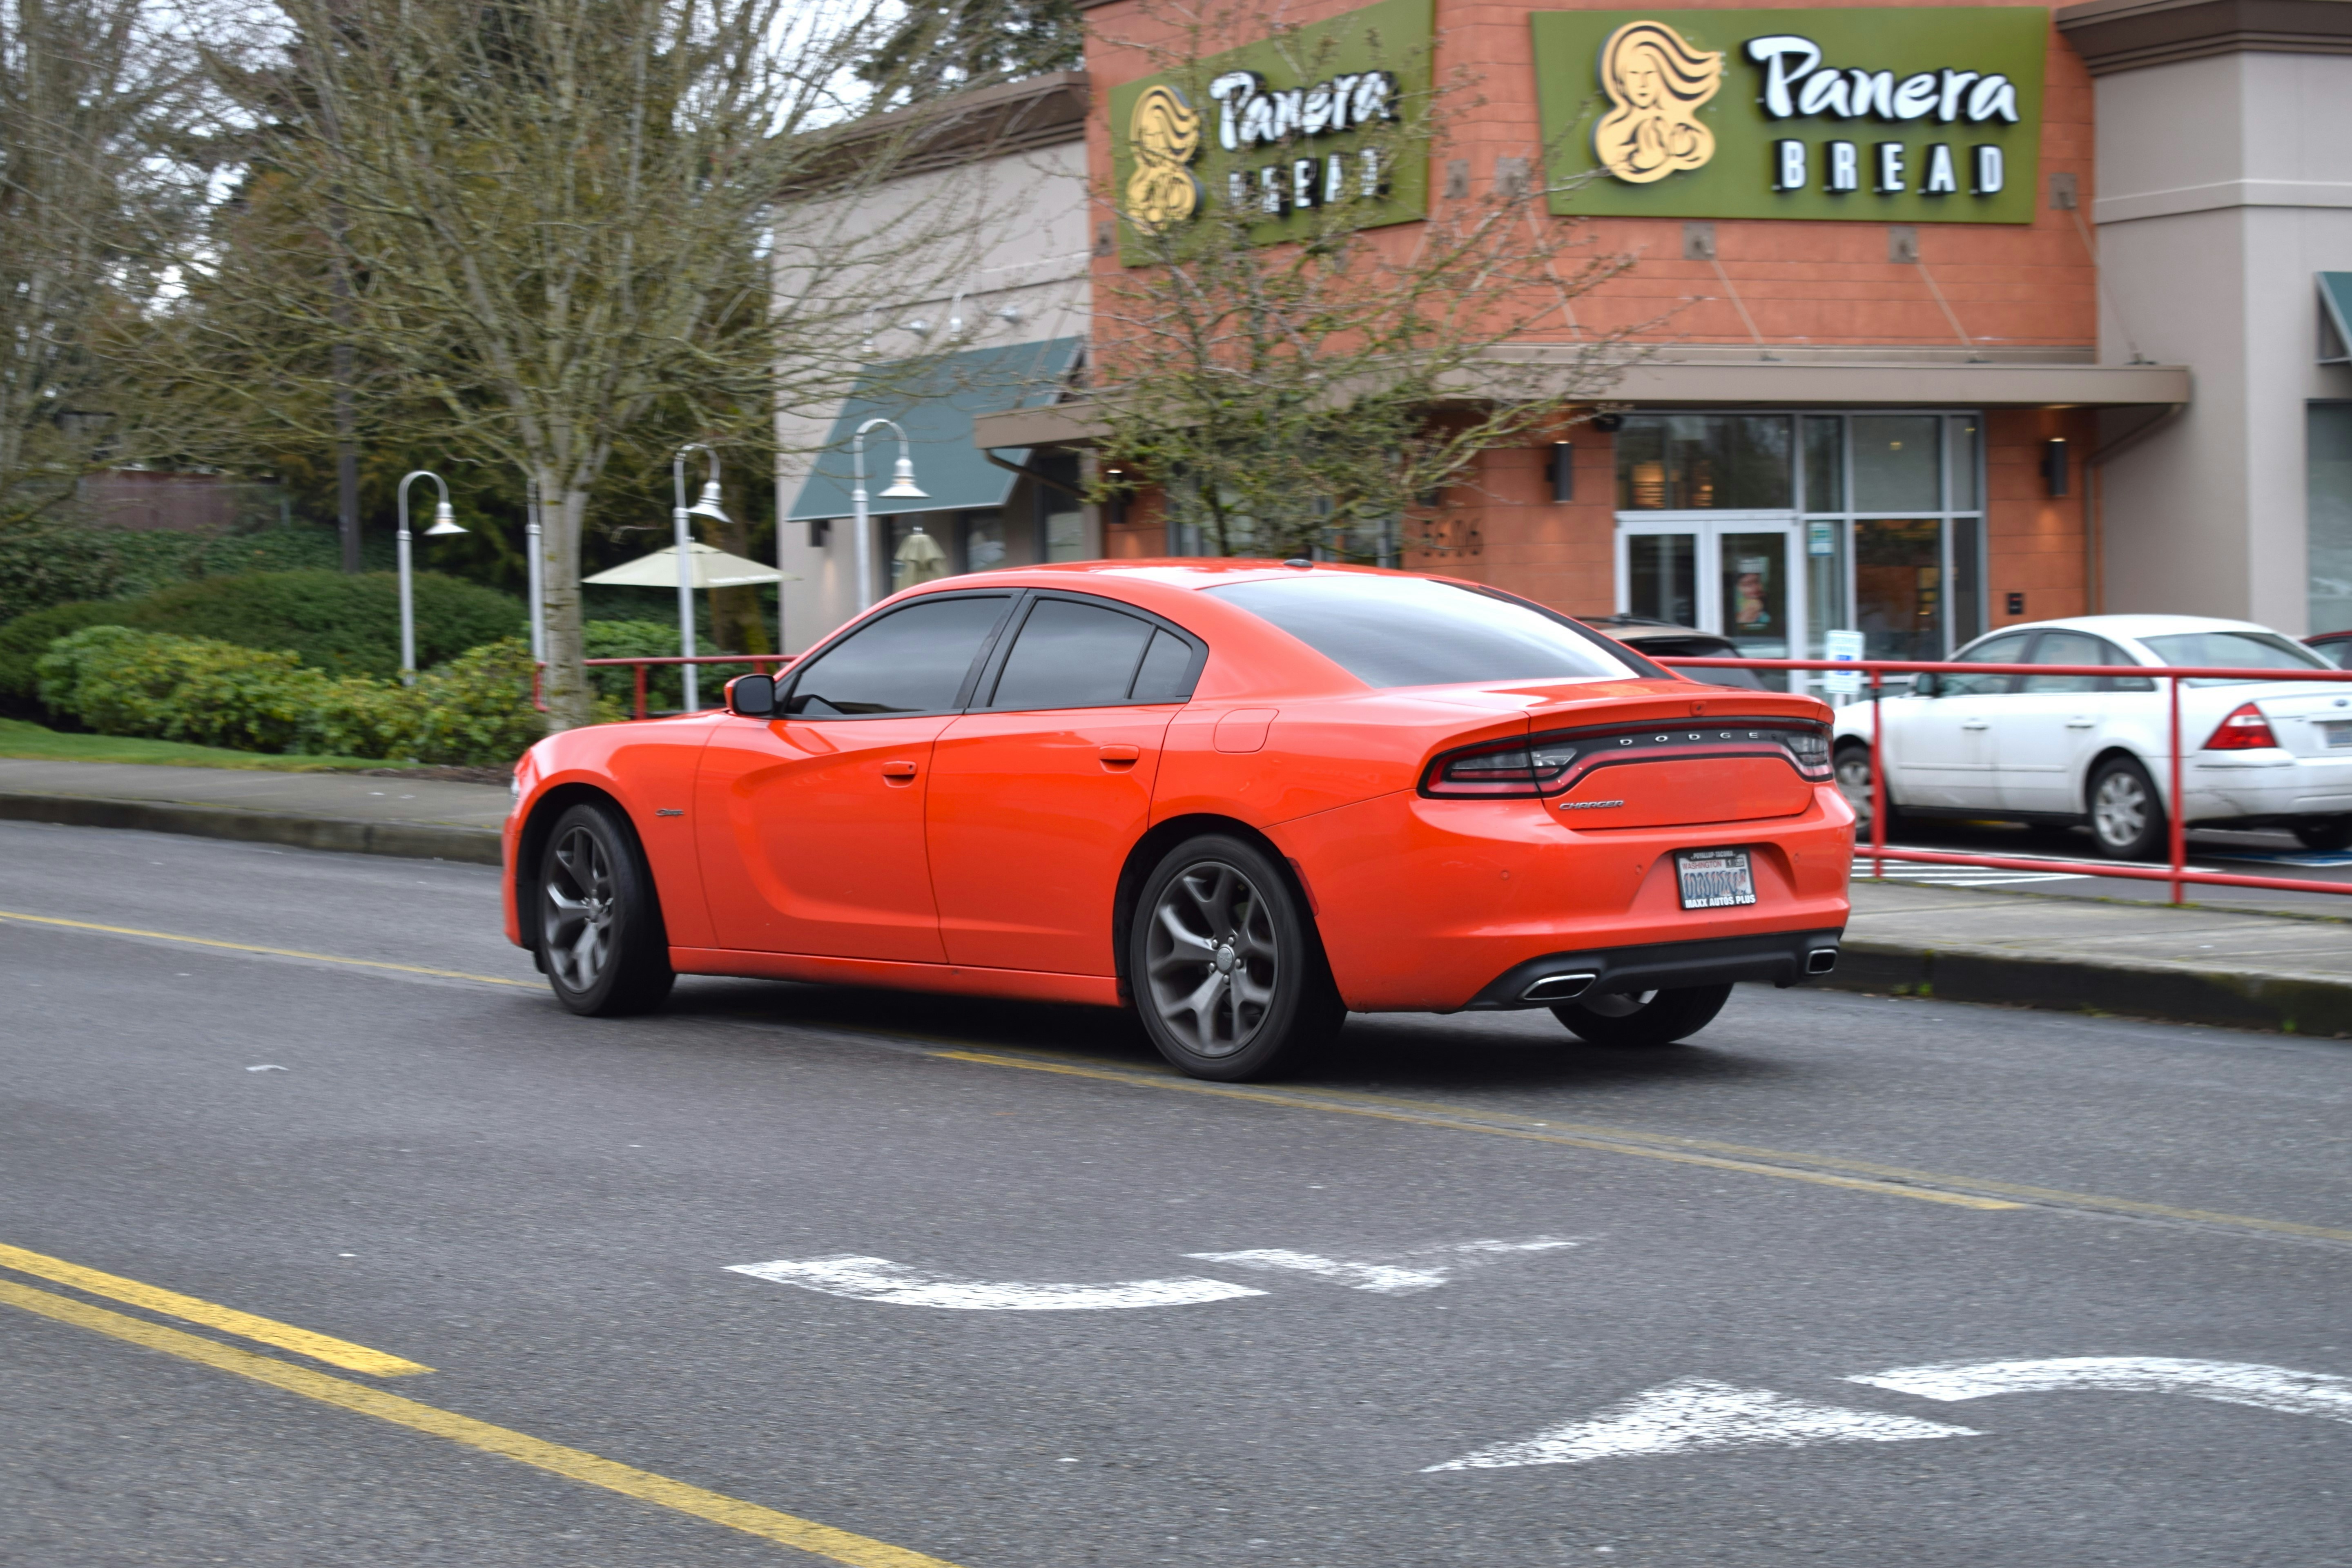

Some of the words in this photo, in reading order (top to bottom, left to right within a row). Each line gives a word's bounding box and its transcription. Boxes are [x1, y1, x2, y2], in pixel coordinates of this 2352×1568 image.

[1748, 35, 2020, 122] Panera
[1210, 71, 1392, 150] Panera
[1781, 140, 2004, 193] BREAD
[1619, 732, 1758, 746] DODGE
[1559, 800, 1624, 810] CHARGER
[1682, 861, 1721, 870] WASHINGTON
[1685, 899, 1708, 908] MAXX
[1710, 897, 1734, 906] AUTOS
[1736, 894, 1755, 904] PLUS
